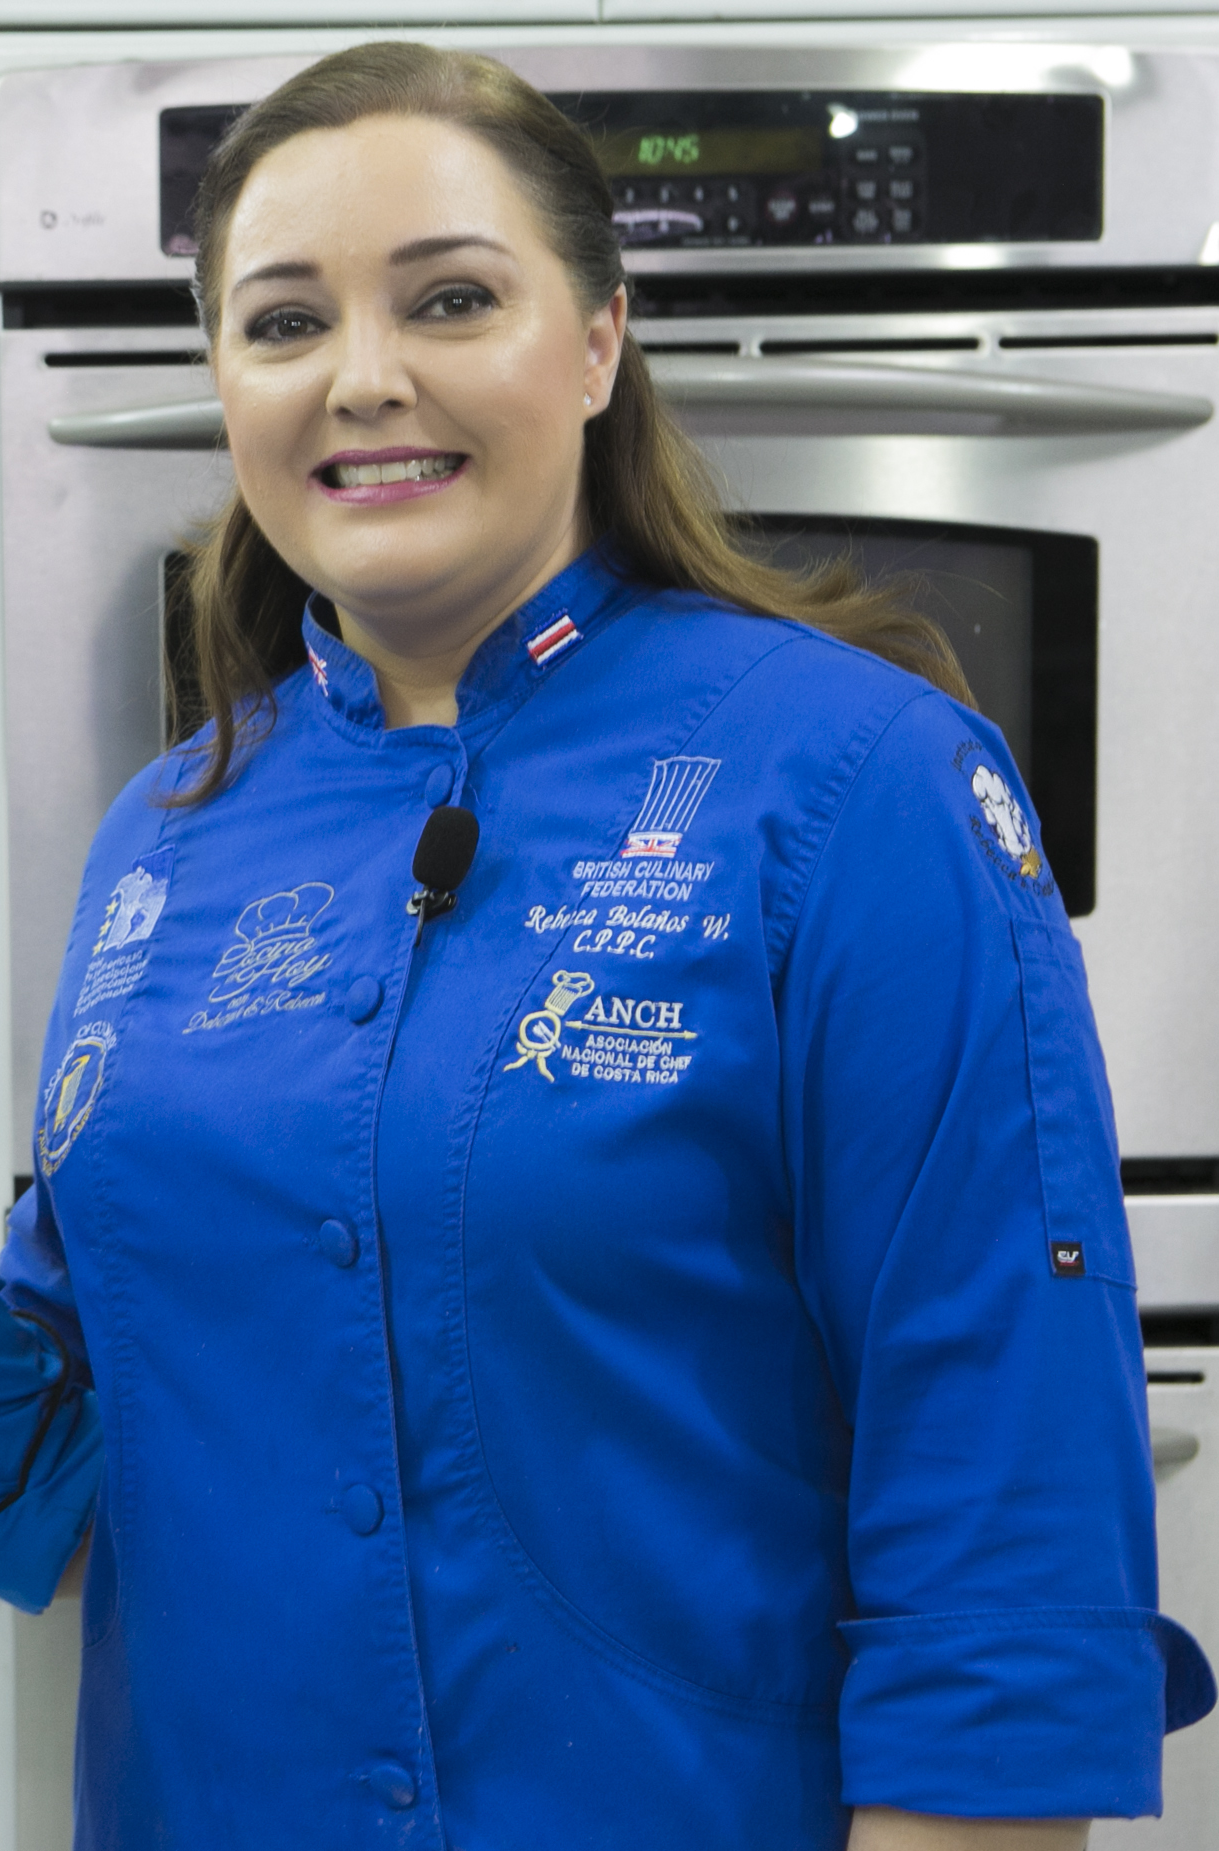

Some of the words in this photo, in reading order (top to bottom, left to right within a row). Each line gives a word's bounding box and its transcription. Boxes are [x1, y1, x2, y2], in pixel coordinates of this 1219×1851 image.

[573, 861, 631, 881] BRITISH
[635, 861, 715, 882] CULINARY
[580, 880, 693, 901] FEDERATION
[606, 905, 689, 933] Bolaños
[703, 913, 731, 940] W.
[584, 996, 684, 1029] ANCH
[561, 1045, 633, 1069] NACIONAL
[637, 1055, 655, 1070] DE
[661, 1056, 692, 1070] CHEF
[572, 1063, 589, 1077] DE
[593, 1066, 642, 1082] COSTA
[646, 1070, 679, 1084] RICA
